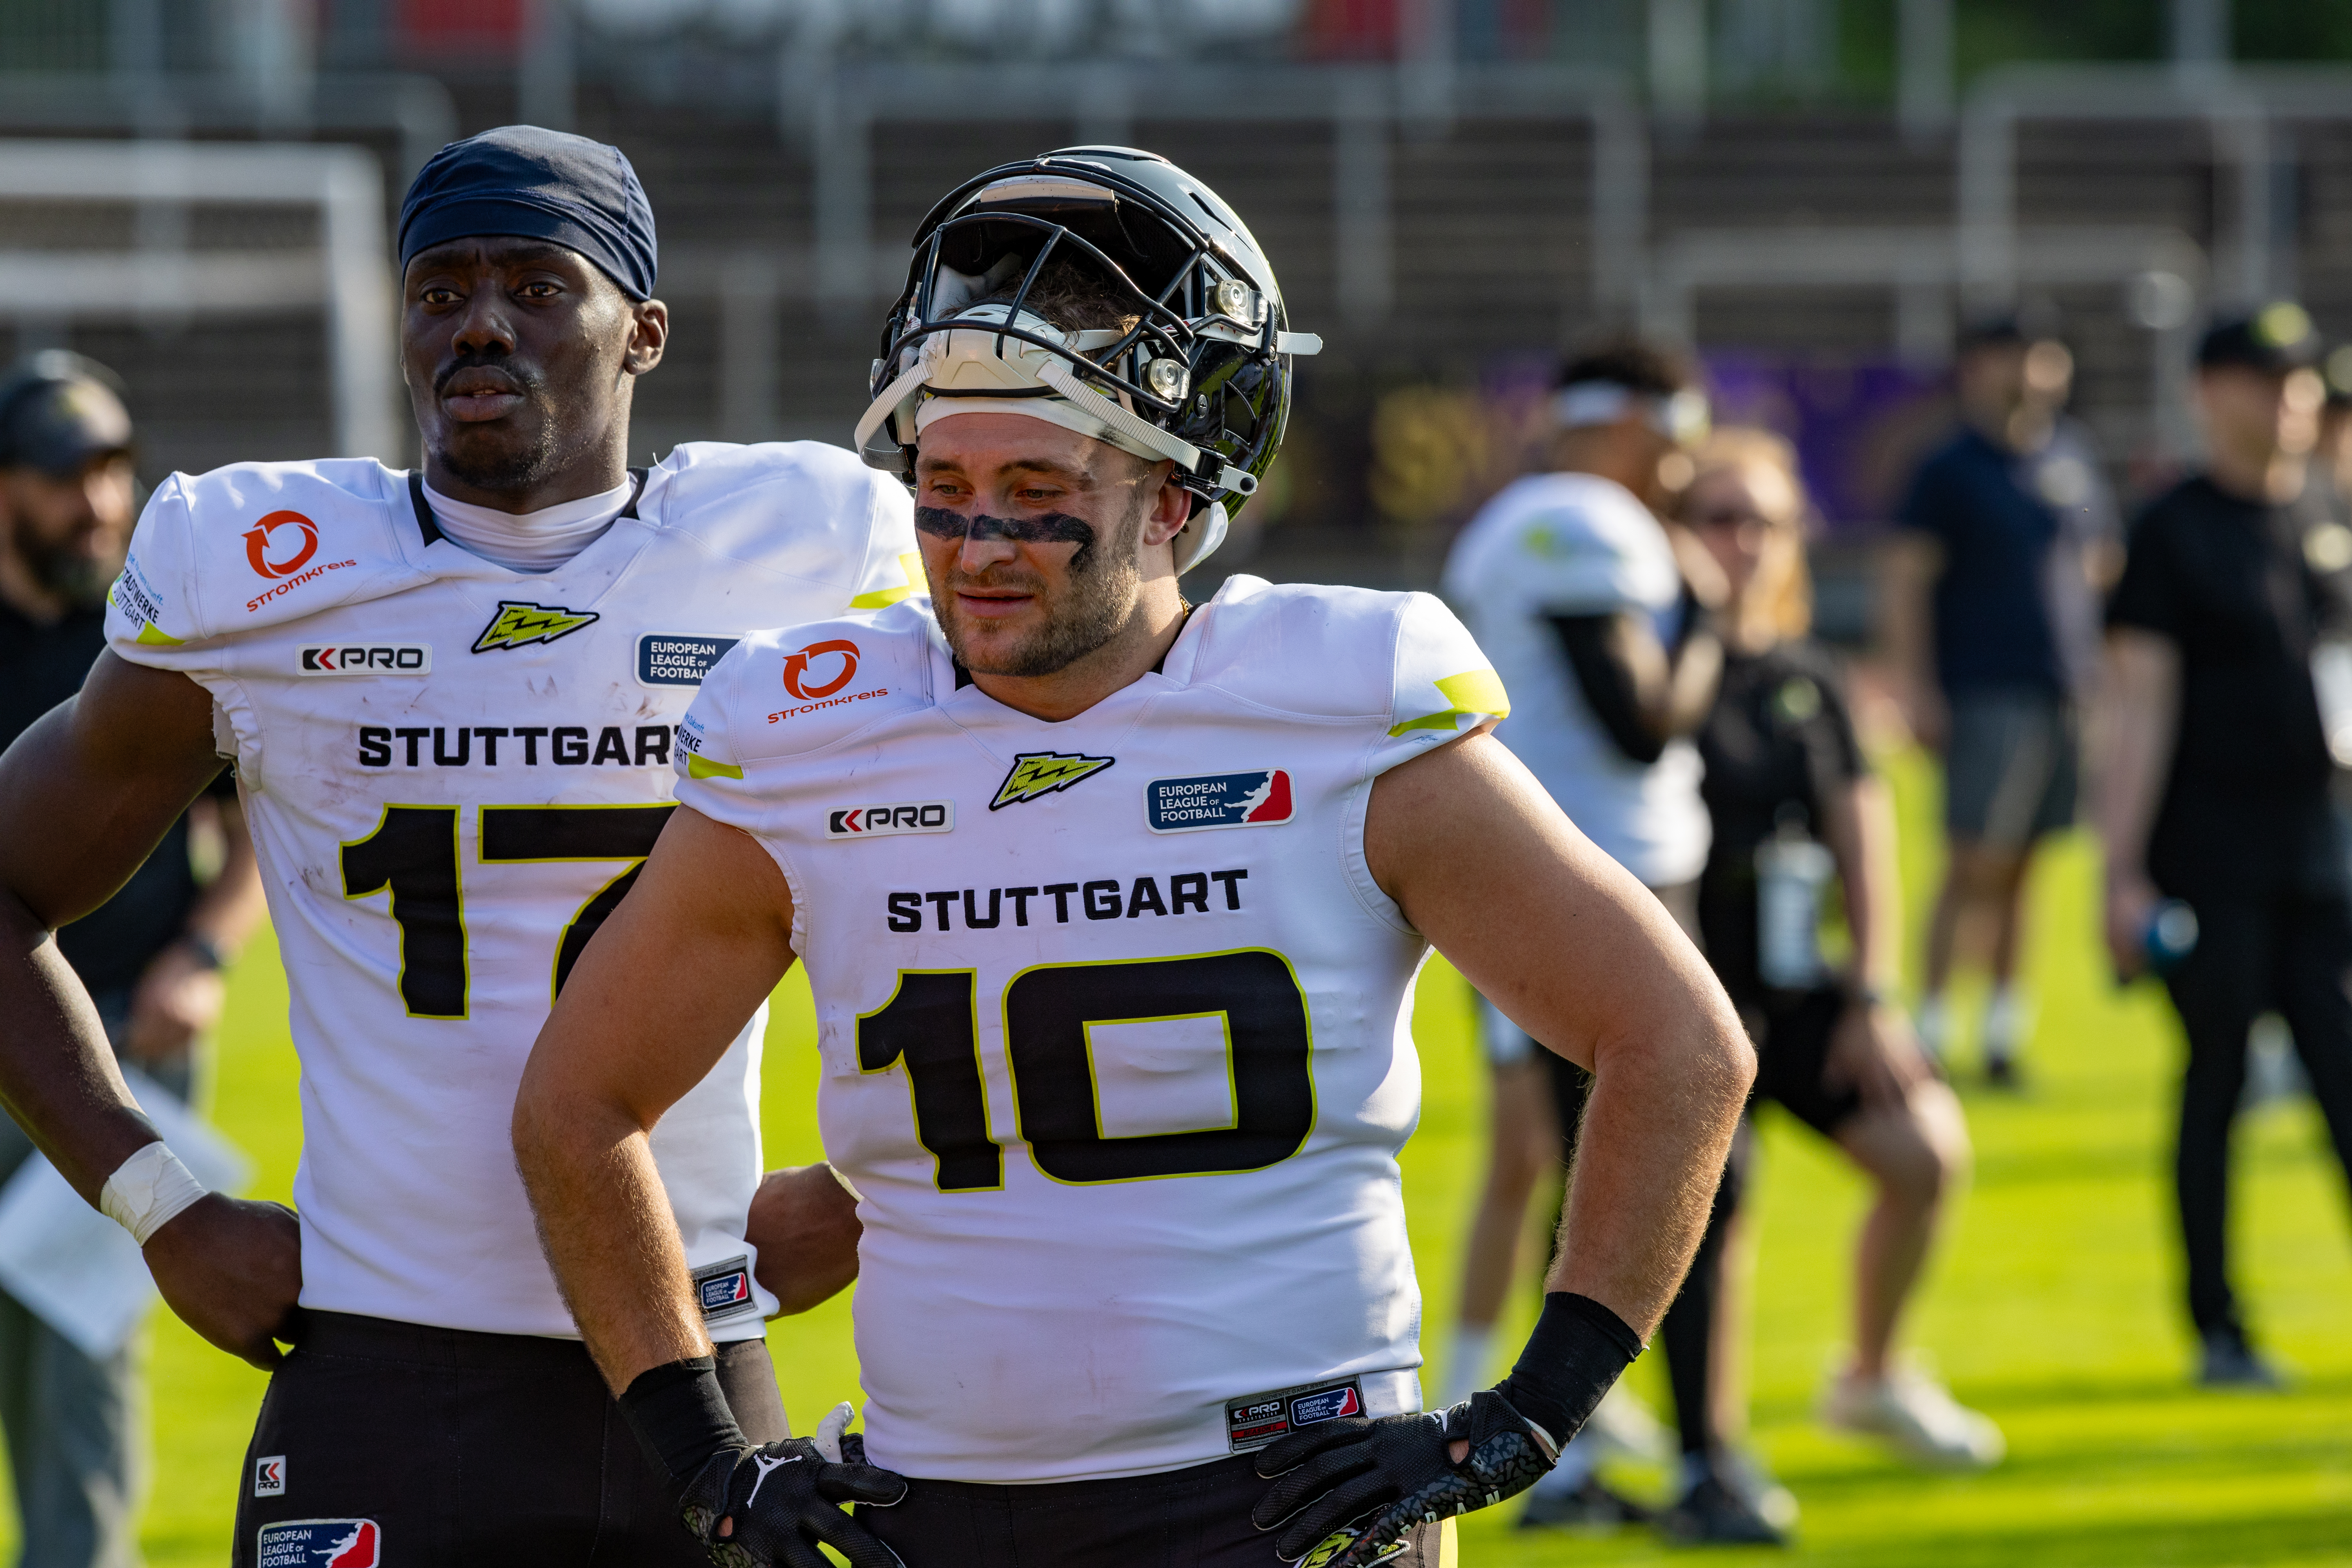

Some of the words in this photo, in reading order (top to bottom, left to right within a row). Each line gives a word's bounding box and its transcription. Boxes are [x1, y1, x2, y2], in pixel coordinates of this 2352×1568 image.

[122, 566, 159, 624] TADTWERKE
[114, 583, 145, 630] TUTTGART
[651, 642, 716, 655] EUROPEAN
[650, 654, 696, 666] LEAGUE
[650, 666, 709, 679] FOOTBAL
[677, 723, 702, 753] WERKE
[359, 725, 681, 767] STUTTGAR
[1159, 782, 1227, 797] EUROPEAN
[1160, 796, 1208, 809] LEAGUE
[1161, 808, 1226, 822] FOOTBALL
[887, 869, 1248, 933] STUTTGART
[339, 801, 681, 1020] 17
[855, 946, 1318, 1194] 10
[706, 1294, 730, 1304] FOOTBALL
[1260, 1390, 1290, 1401] AUTHENTIC
[1292, 1385, 1308, 1394] GAME
[1310, 1381, 1328, 1390] JERSEY
[1298, 1397, 1329, 1409] EUROPEAN
[1239, 1411, 1277, 1423] SPORTSWEAR
[1298, 1406, 1321, 1415] LEAGUE
[1299, 1410, 1330, 1421] FOOTBALL
[258, 1480, 279, 1490] PRO
[263, 1530, 311, 1544] EUROPEAN
[263, 1543, 294, 1556] LEAGUE
[262, 1553, 306, 1568] FOOTBALL
